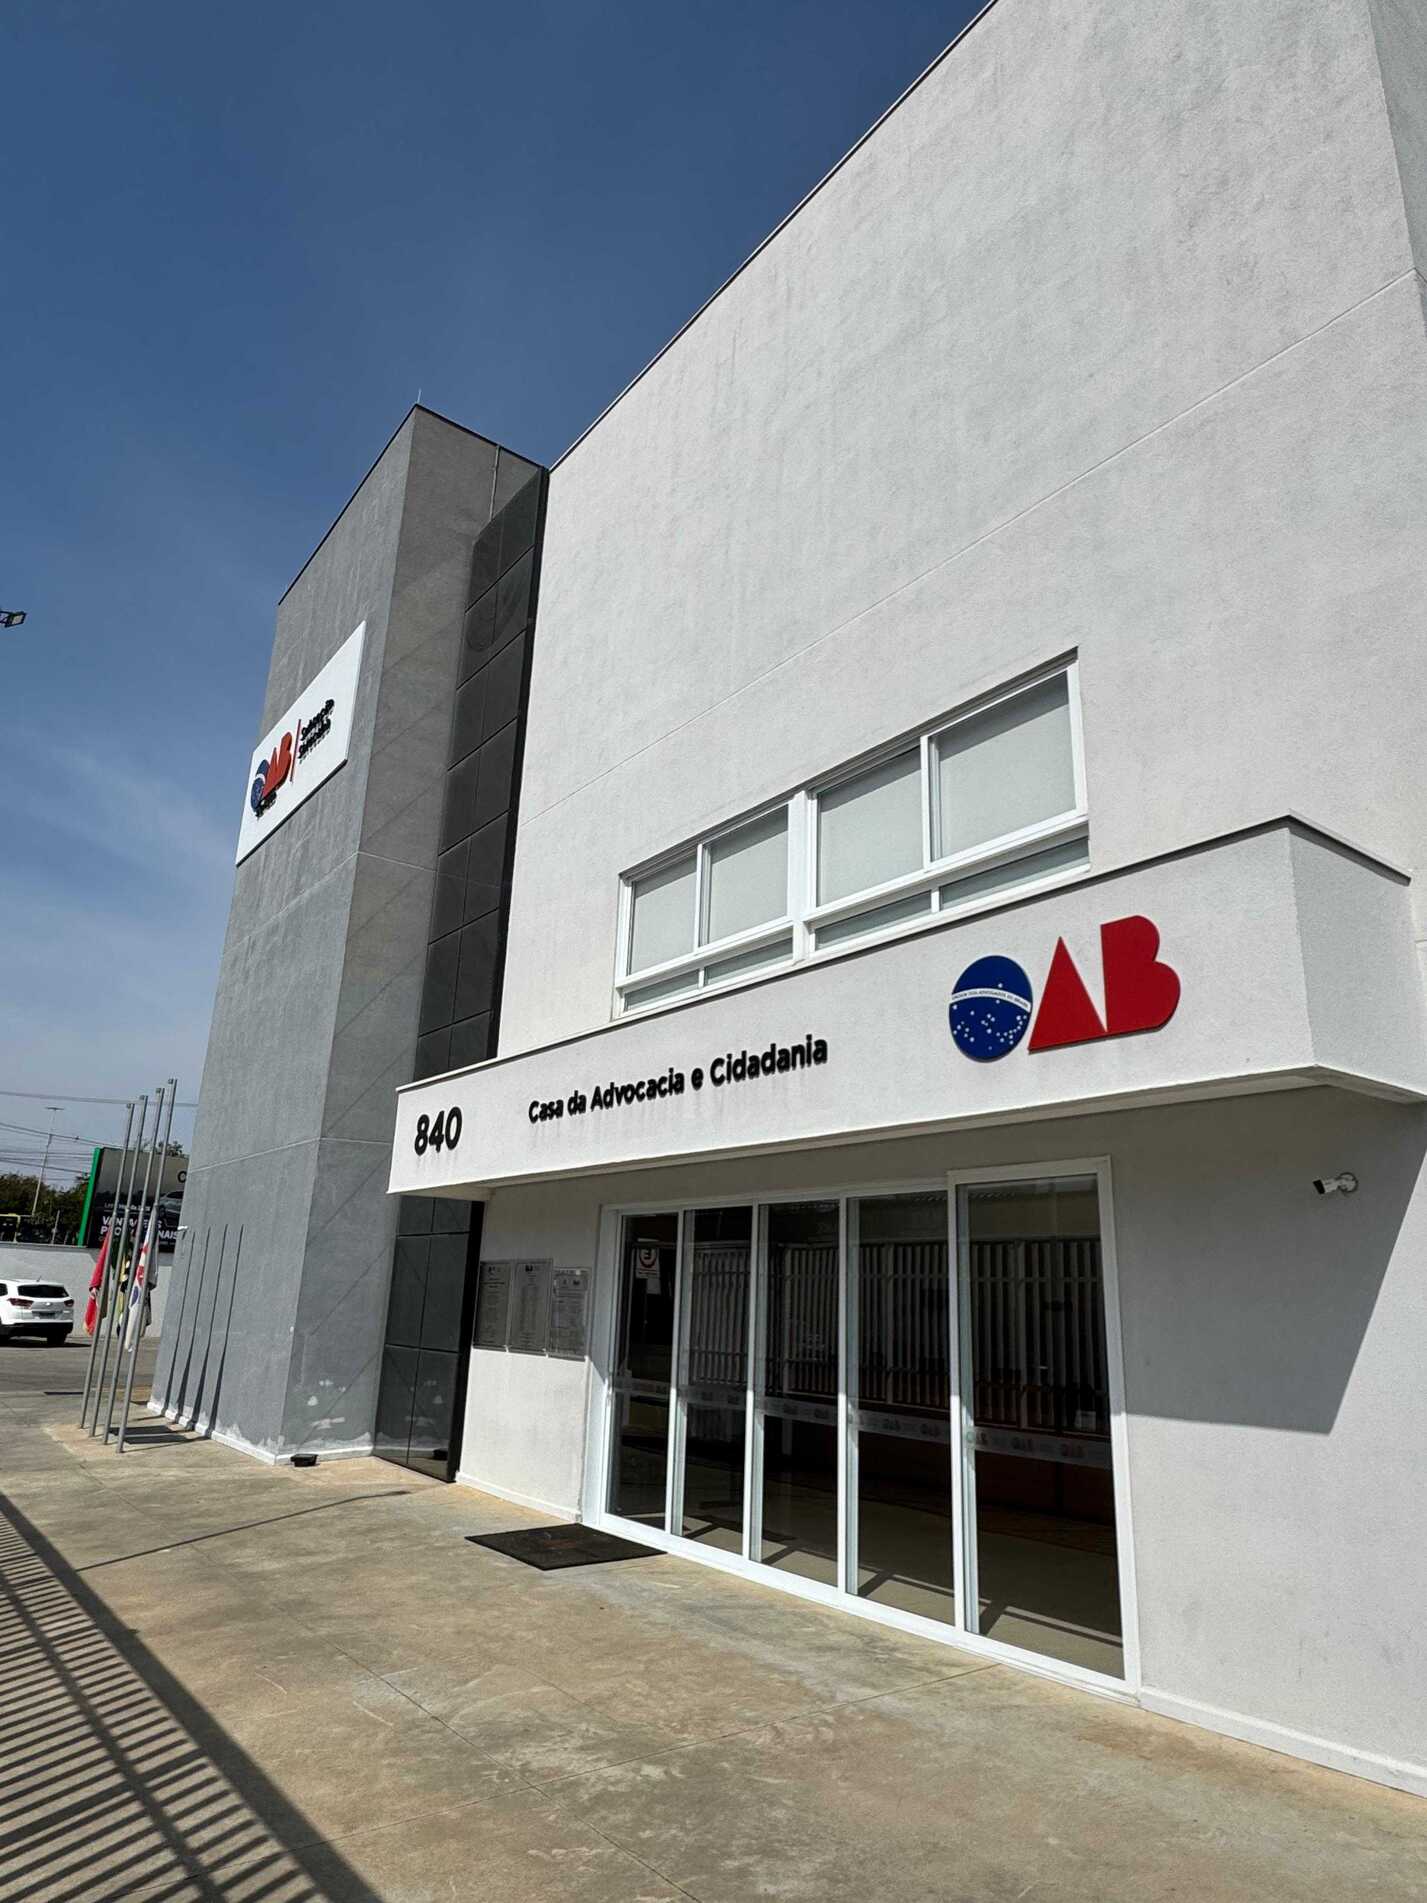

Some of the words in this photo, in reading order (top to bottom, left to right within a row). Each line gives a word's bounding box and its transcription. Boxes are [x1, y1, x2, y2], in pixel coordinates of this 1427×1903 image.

[949, 915, 1181, 1063] OAB
[529, 1100, 564, 1124] Casa
[567, 1089, 587, 1116] da
[590, 1067, 685, 1112] Advocacia
[690, 1067, 704, 1091] e
[709, 1033, 828, 1087] Cidadania
[414, 1106, 463, 1157] 840
